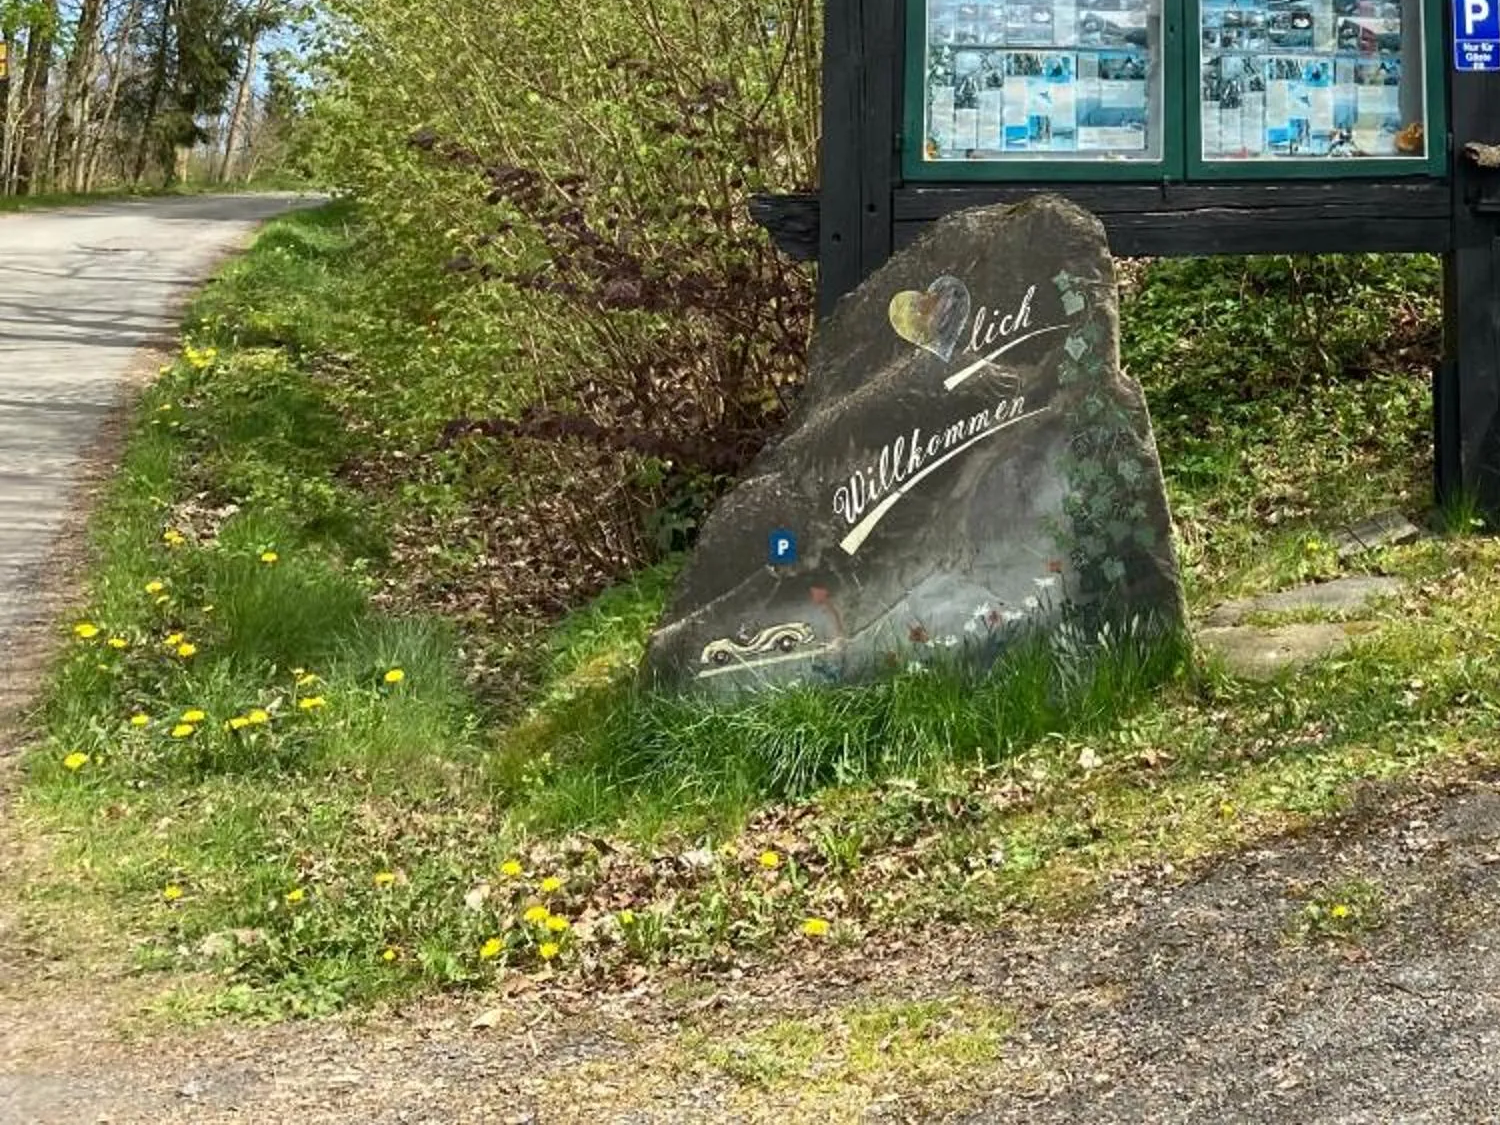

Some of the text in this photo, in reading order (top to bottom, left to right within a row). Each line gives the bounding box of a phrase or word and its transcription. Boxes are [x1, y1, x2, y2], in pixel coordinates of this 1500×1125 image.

[962, 284, 1036, 355] lich
[833, 395, 1026, 525] Willkommen
[777, 538, 789, 556] P
